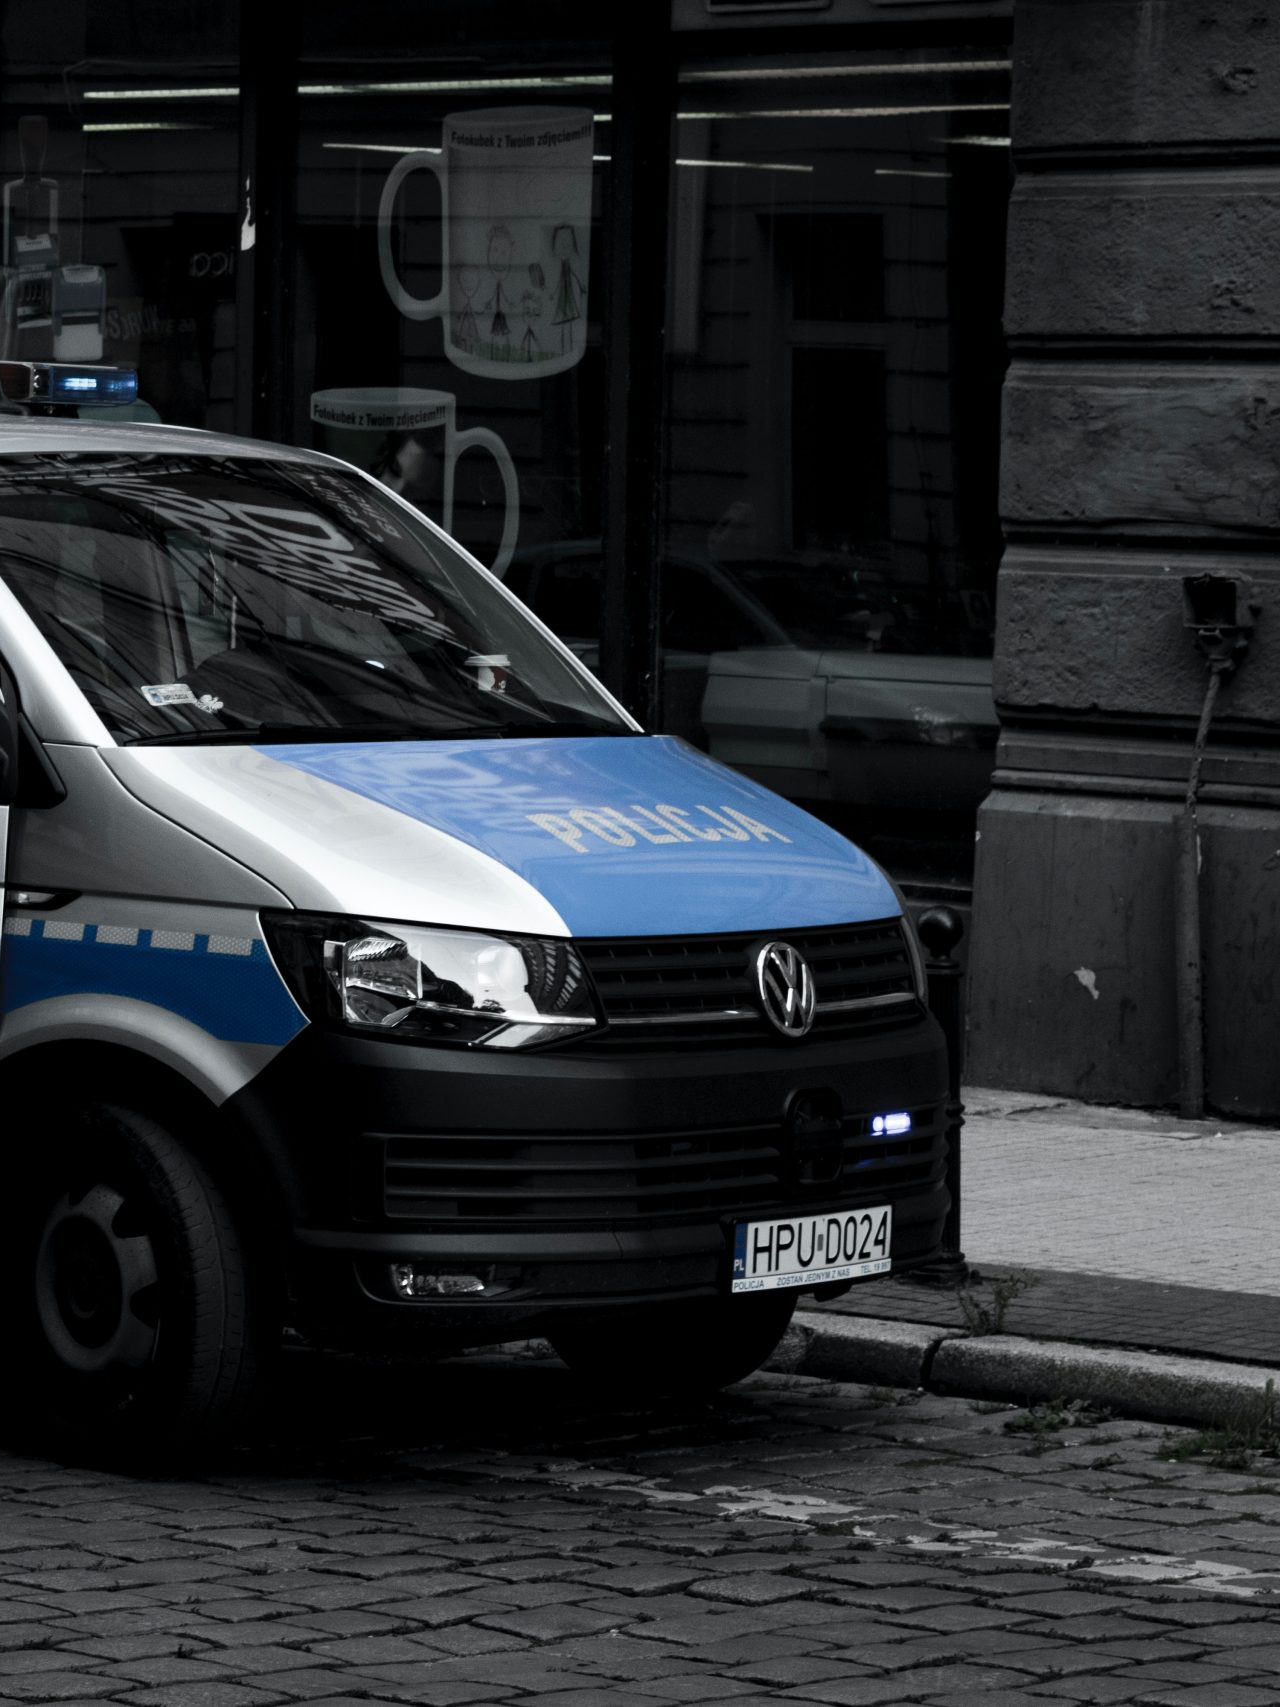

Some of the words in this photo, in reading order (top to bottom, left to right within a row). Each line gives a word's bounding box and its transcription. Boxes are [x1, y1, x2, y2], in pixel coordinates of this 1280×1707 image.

[451, 131, 495, 148] Fotokubek
[497, 136, 503, 148] z
[505, 134, 535, 149] Twoim
[313, 404, 356, 425] Fotokubek
[358, 415, 364, 427] z
[366, 413, 394, 428] Twoim
[527, 803, 792, 853] POLICJA
[733, 1258, 745, 1273] PL
[733, 1280, 765, 1291] POLICJA
[804, 1270, 832, 1283] JEDNYM
[838, 1267, 851, 1278] NAS
